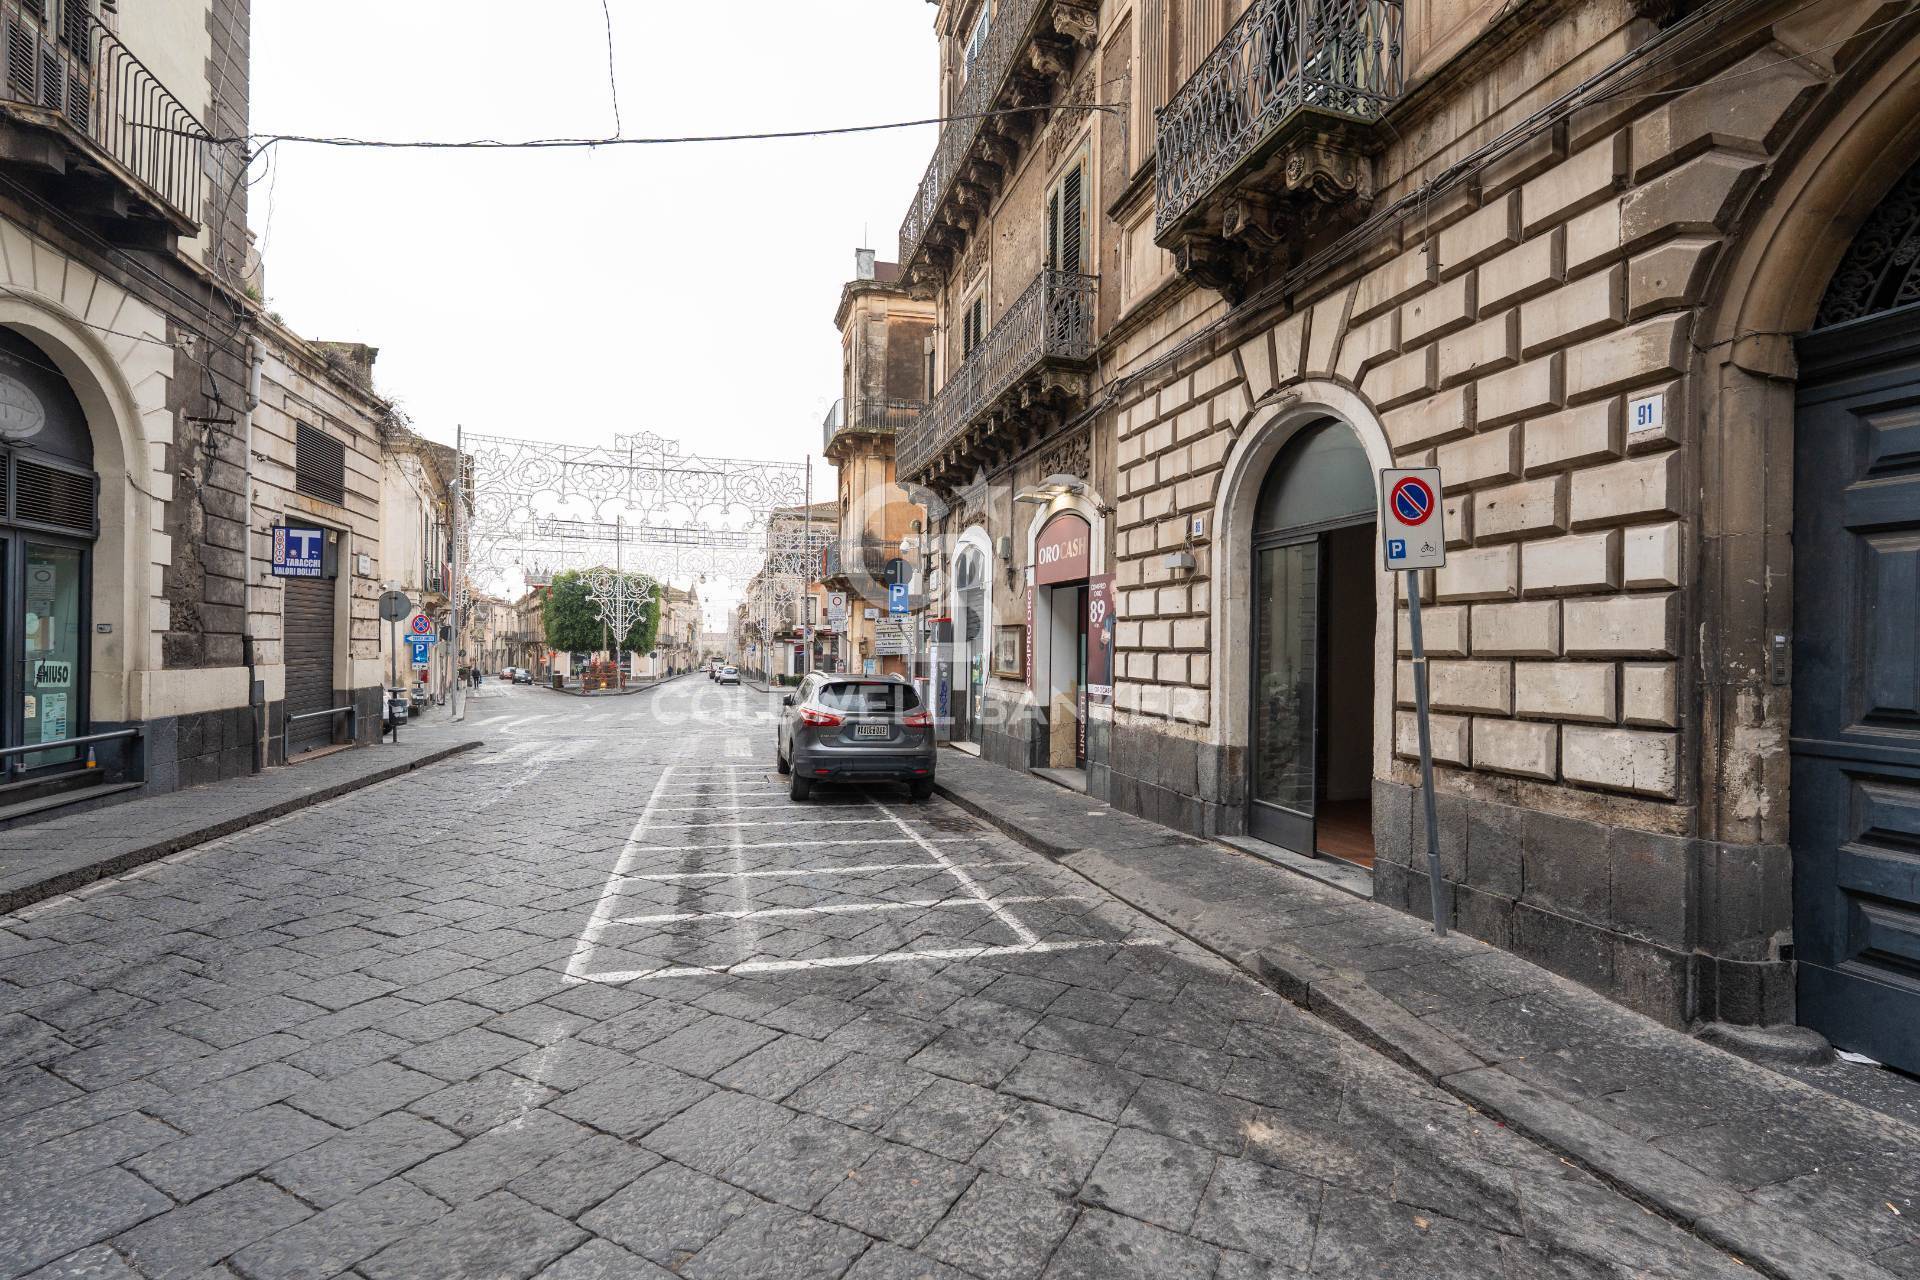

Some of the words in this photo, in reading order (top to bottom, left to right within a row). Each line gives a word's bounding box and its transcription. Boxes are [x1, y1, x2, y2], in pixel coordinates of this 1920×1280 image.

[1637, 403, 1652, 426] 91
[289, 529, 321, 558] T
[1392, 542, 1403, 557] P
[286, 558, 321, 568] TABACCHI
[274, 566, 296, 575] VALORI
[296, 567, 321, 576] BOLLATI
[892, 586, 905, 602] P
[1090, 599, 1106, 623] 89
[415, 644, 425, 654] P
